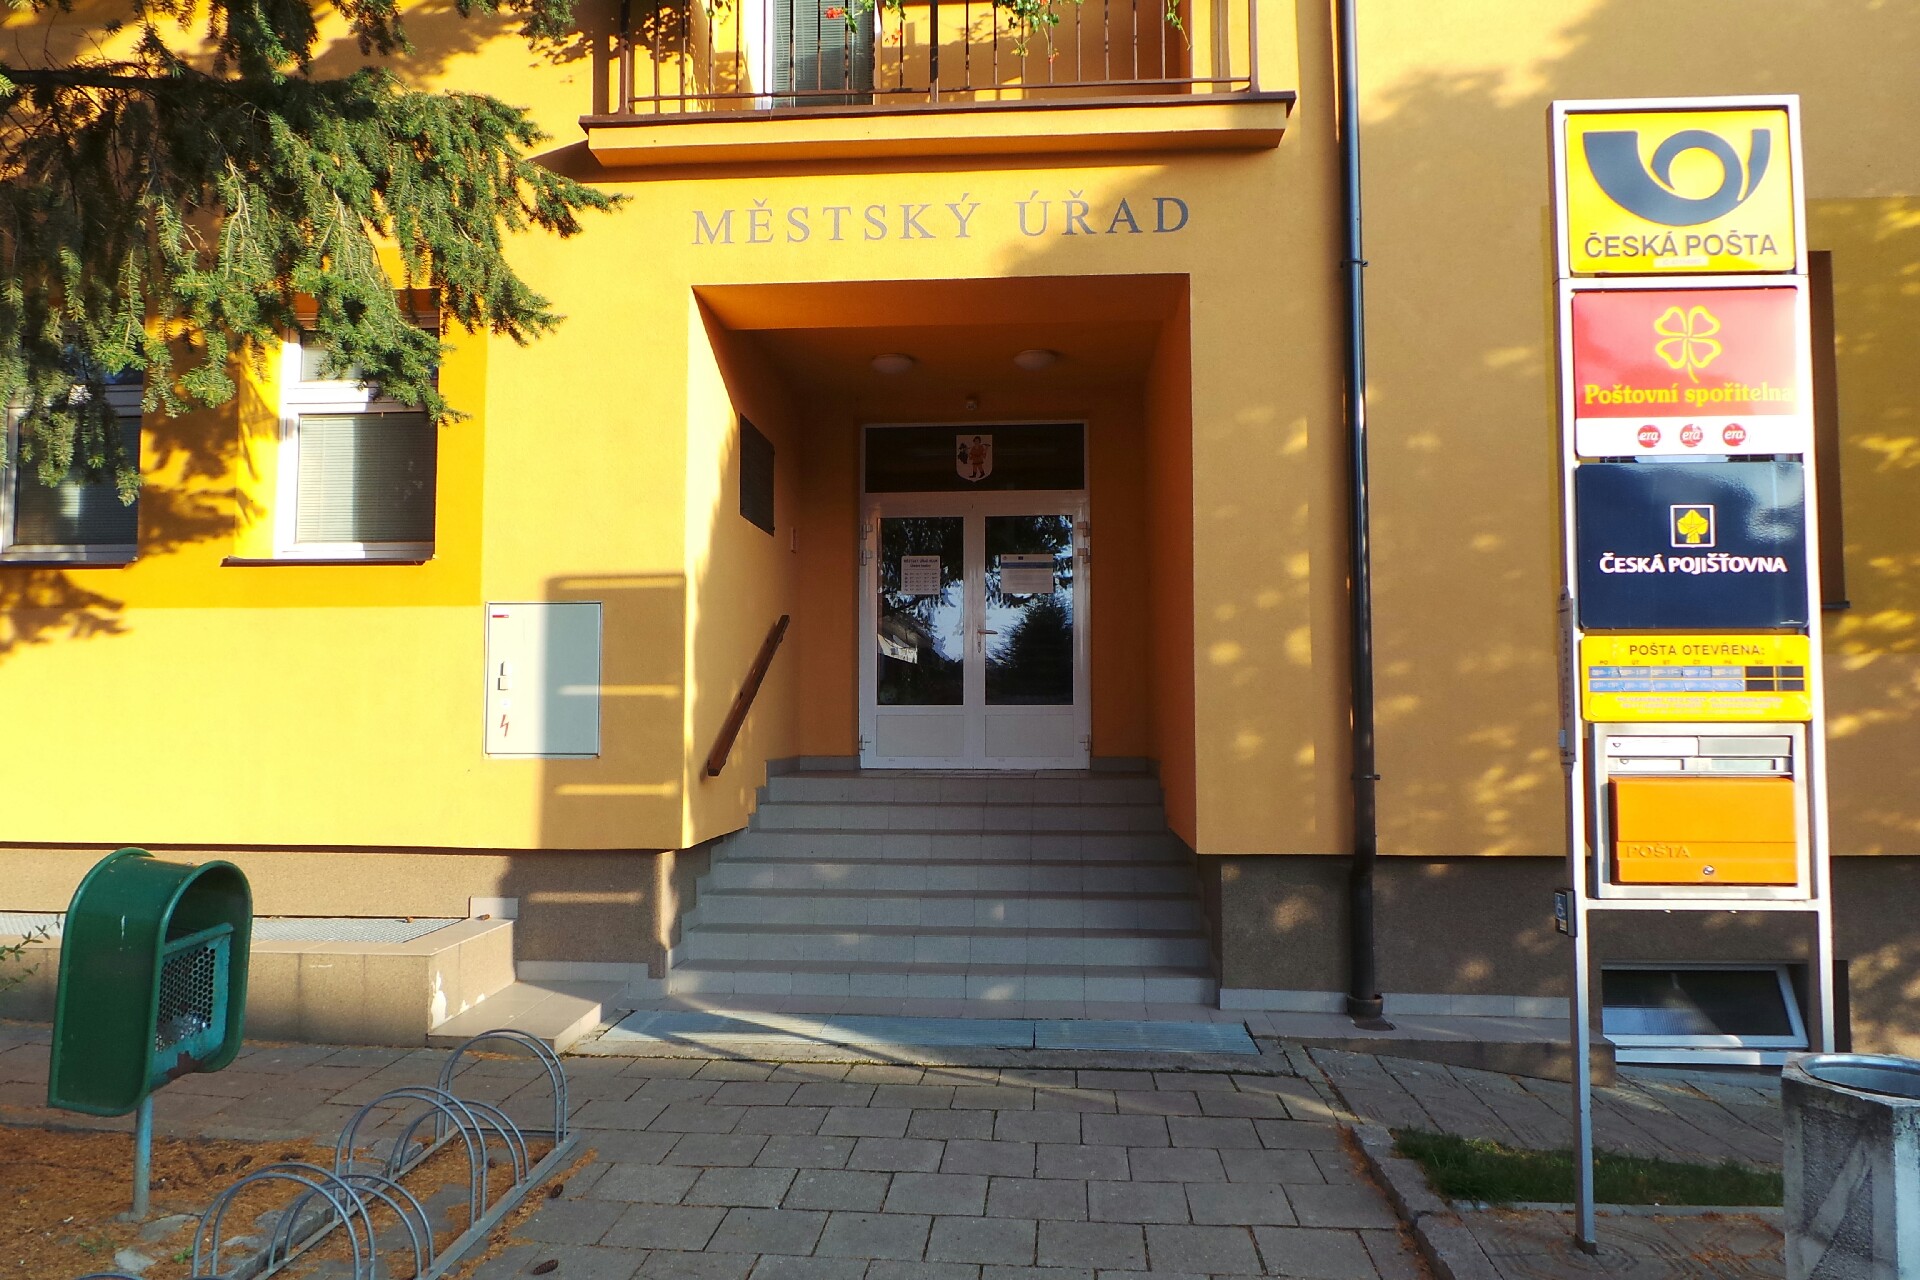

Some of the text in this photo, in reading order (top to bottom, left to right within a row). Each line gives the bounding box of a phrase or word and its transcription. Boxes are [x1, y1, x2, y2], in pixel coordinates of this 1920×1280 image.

[691, 189, 1190, 246] MĚSTSKÝ ÚŘAD
[1584, 230, 1778, 258] ČESKÁ POŠTA
[1584, 381, 1794, 408] Poštovní spořitelna
[1639, 431, 1659, 441] era
[1682, 431, 1701, 440] era
[1725, 430, 1744, 440] era
[1599, 552, 1788, 575] ČESKÁ POJIŠŤOVNA
[1629, 642, 1766, 656] POŠTA OTEVŘENA:
[1626, 843, 1691, 858] POŠTA
